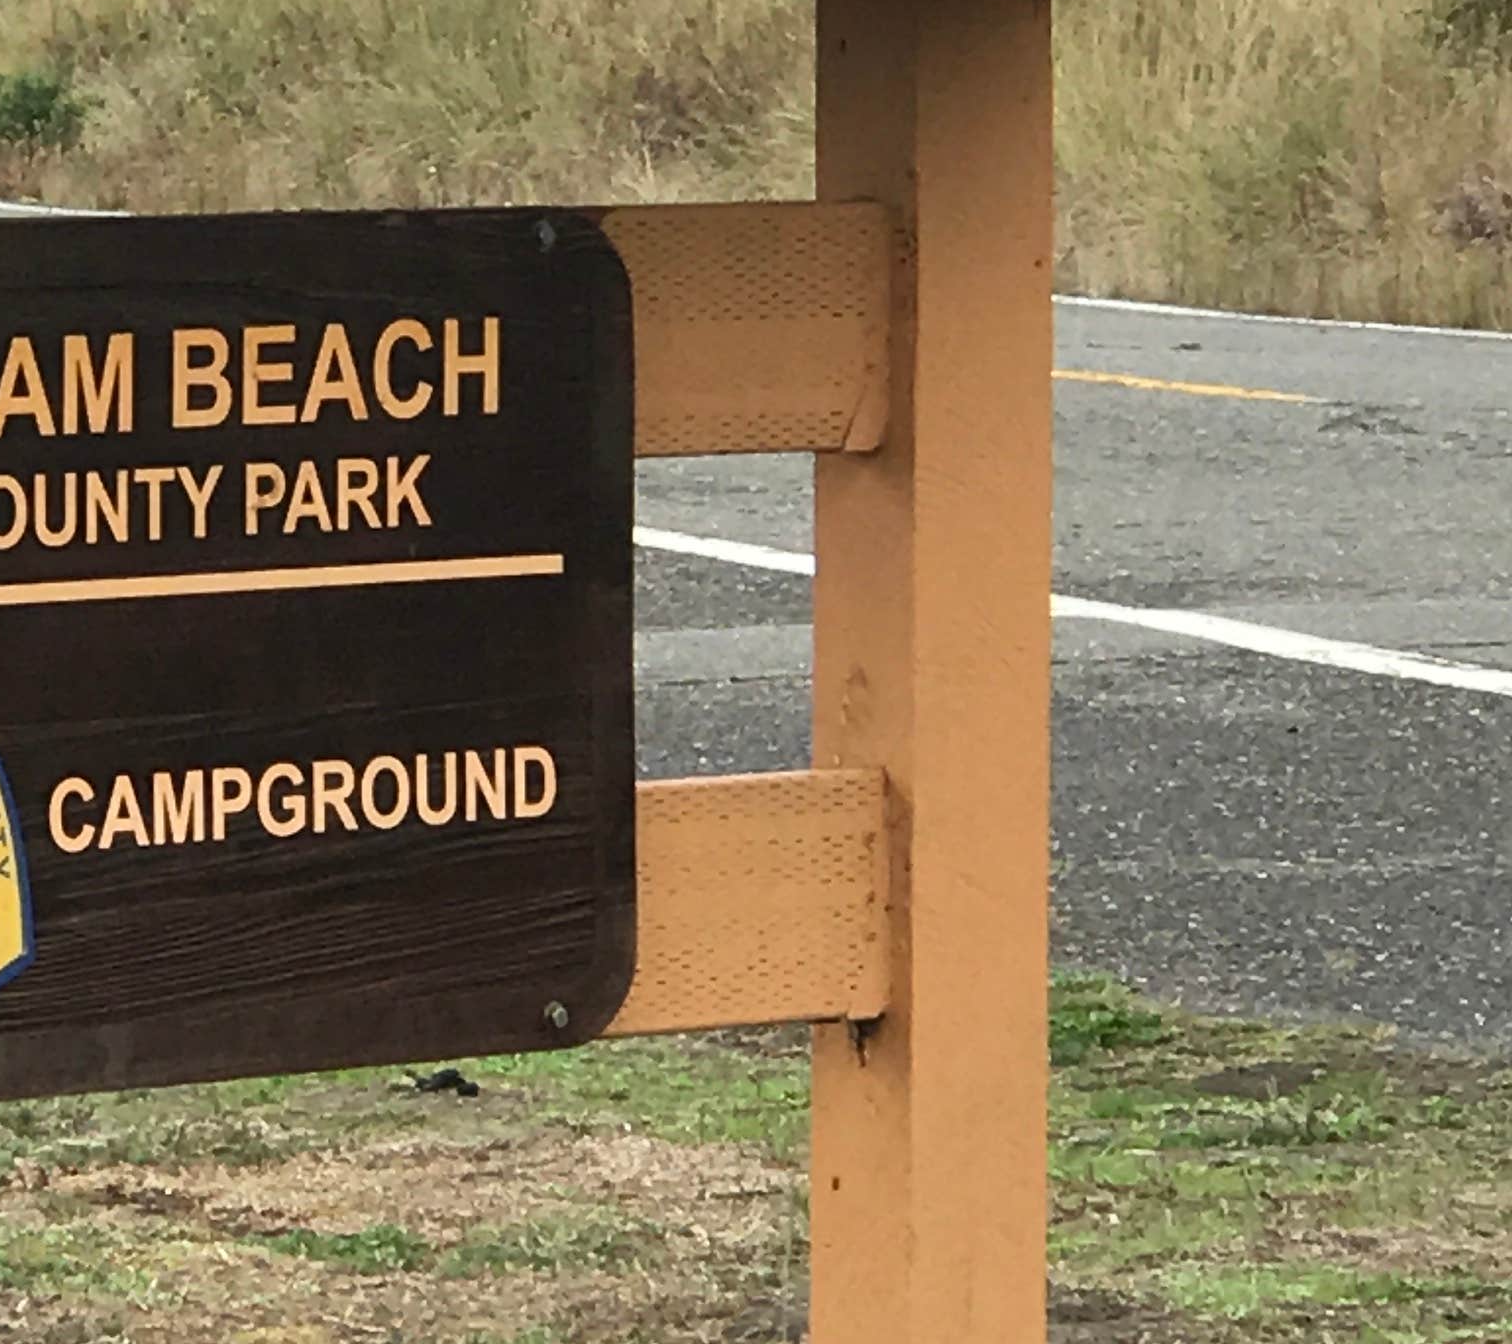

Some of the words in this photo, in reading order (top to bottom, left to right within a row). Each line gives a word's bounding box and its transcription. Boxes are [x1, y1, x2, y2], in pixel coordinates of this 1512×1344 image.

[171, 316, 501, 430] BEACH
[244, 453, 433, 536] PARK
[47, 745, 558, 854] CAMPGROUND
